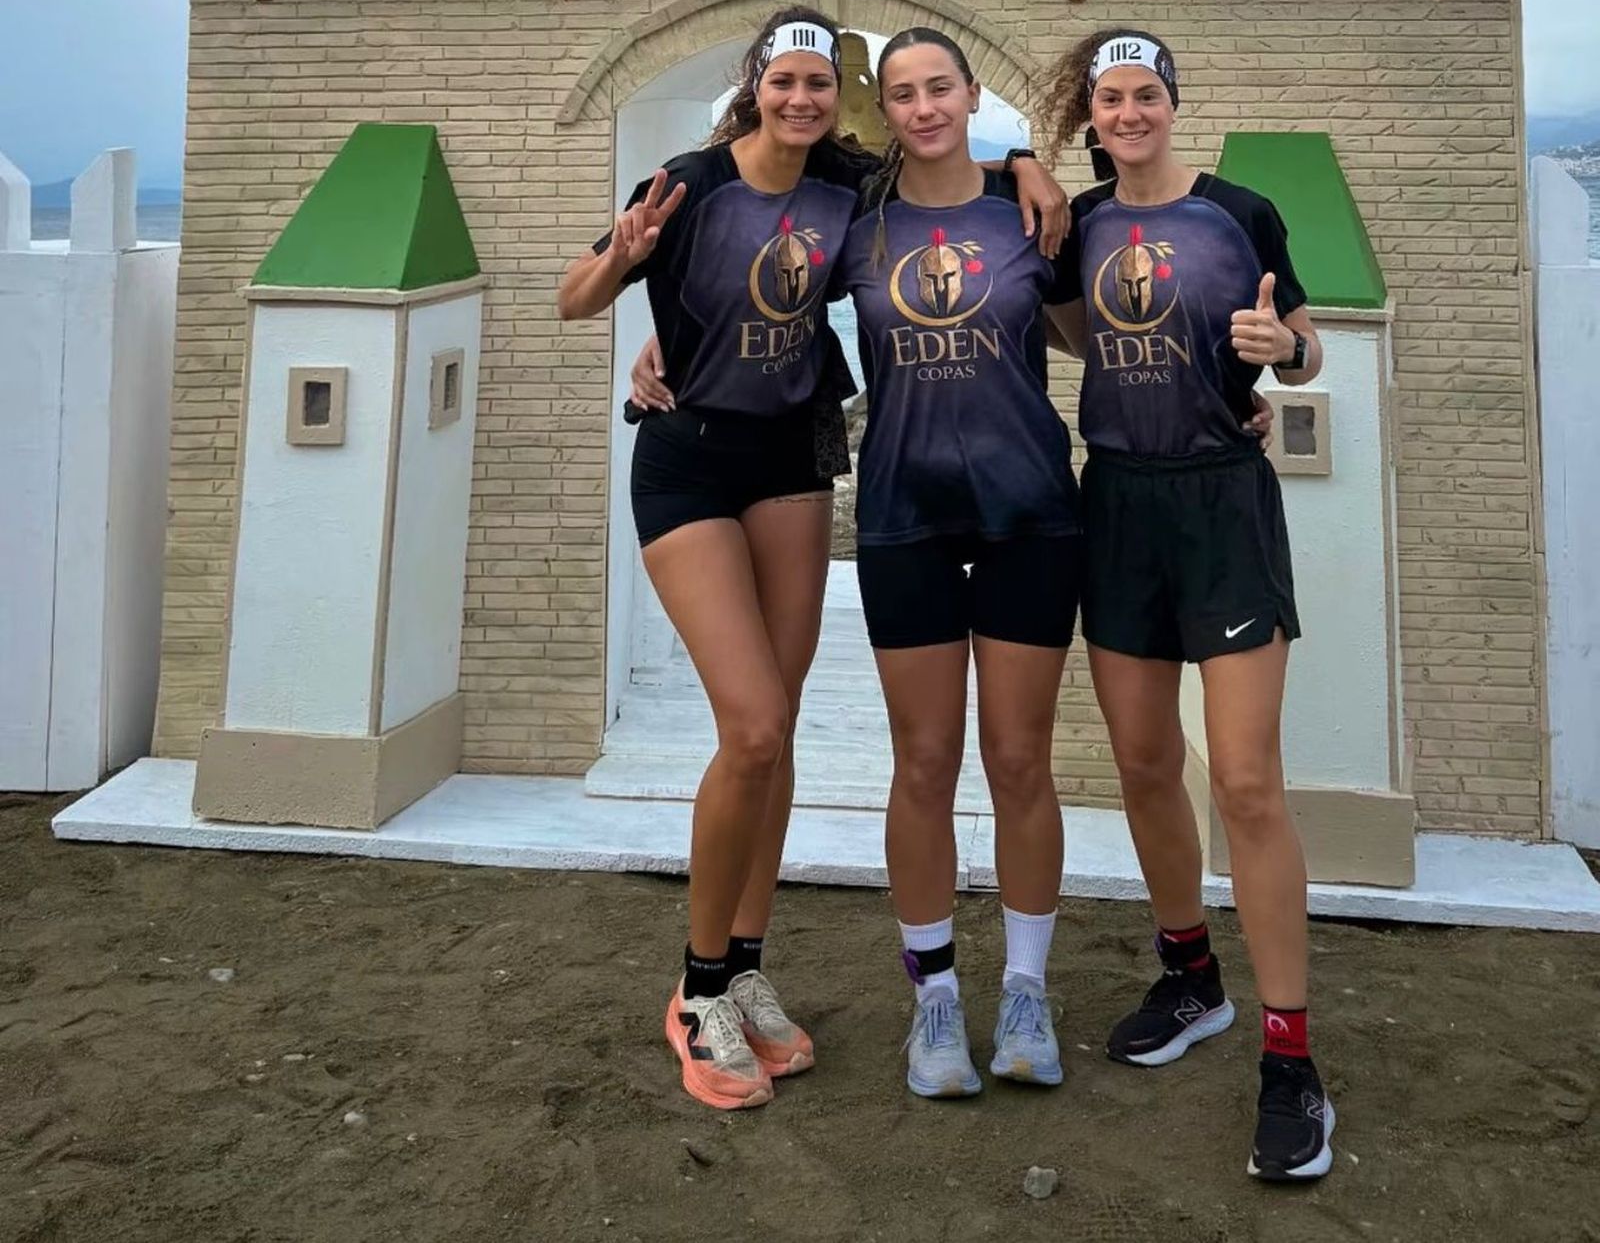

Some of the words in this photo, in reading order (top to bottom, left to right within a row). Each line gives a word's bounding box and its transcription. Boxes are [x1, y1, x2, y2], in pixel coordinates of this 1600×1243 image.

[793, 29, 815, 47] 1111
[1110, 42, 1142, 62] 1112
[888, 321, 1001, 366] EDÉN
[917, 364, 976, 381] COPAS
[1118, 370, 1172, 386] COPAS
